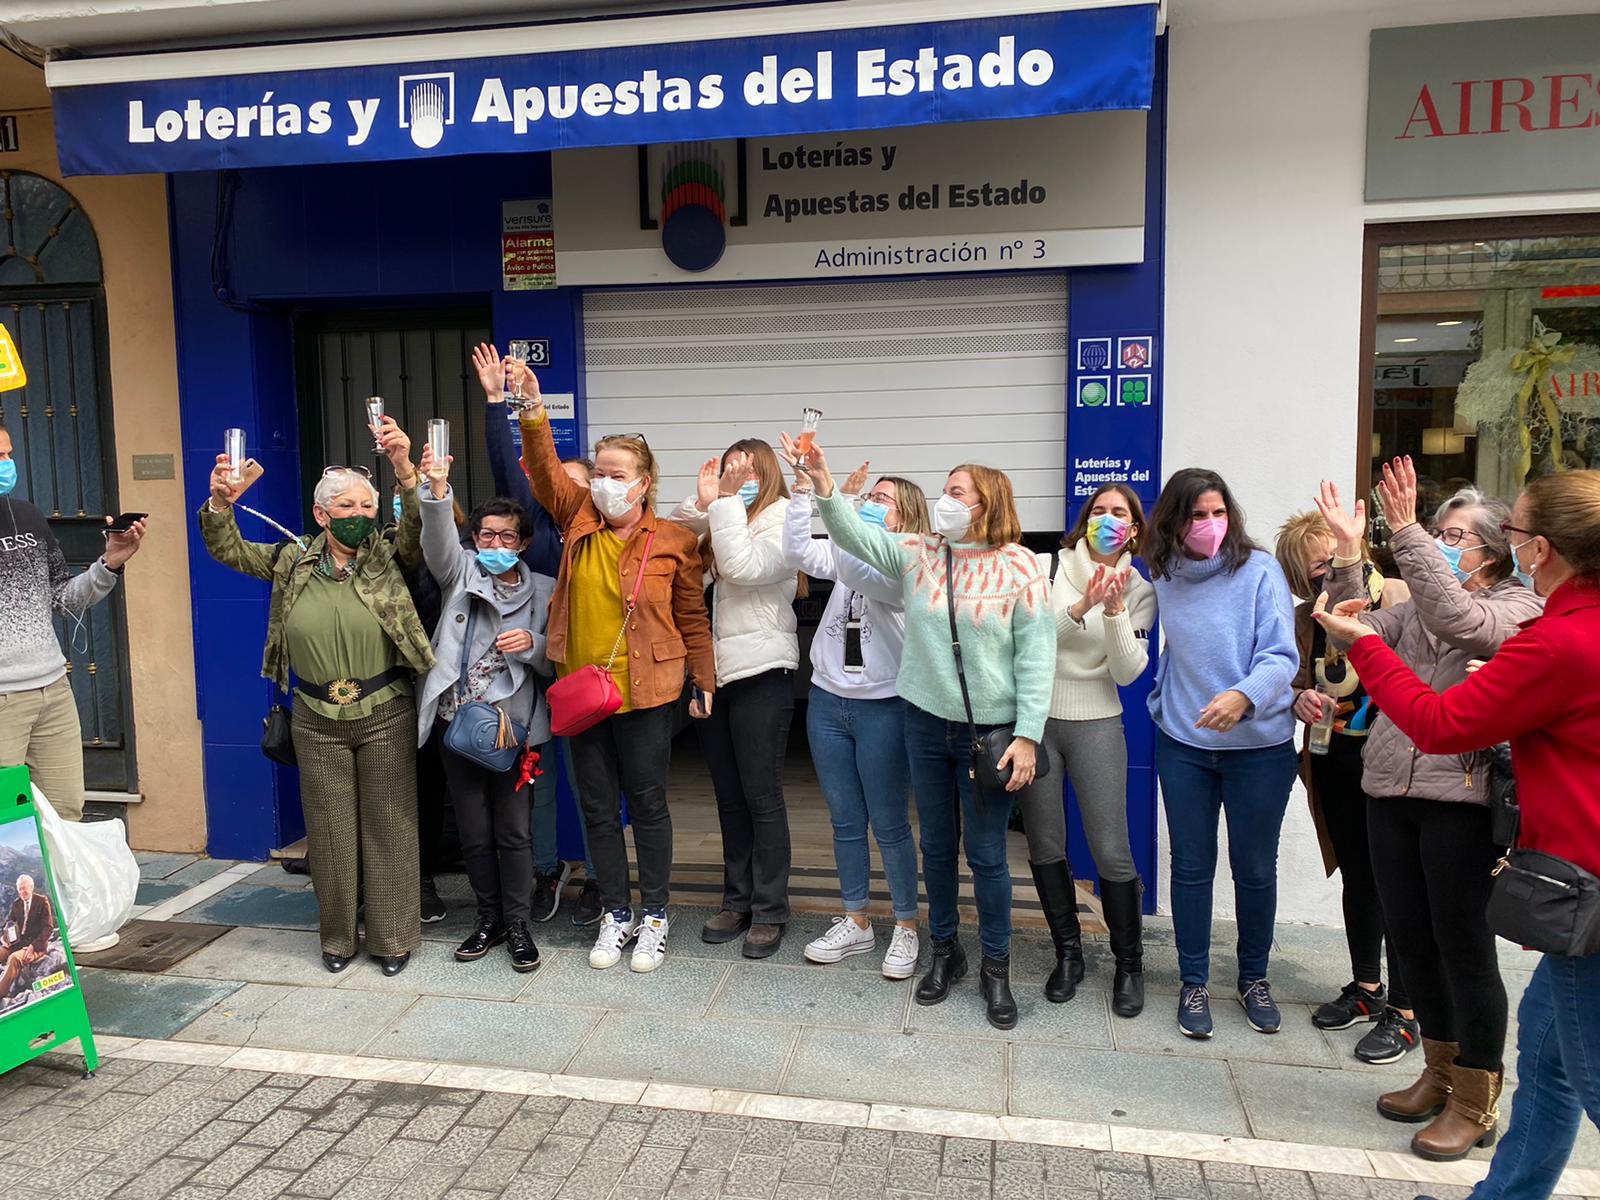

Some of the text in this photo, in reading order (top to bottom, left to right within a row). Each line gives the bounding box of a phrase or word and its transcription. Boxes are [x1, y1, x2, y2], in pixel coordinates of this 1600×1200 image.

[128, 35, 1055, 147] Loterías y Apuestas del Estado
[1394, 73, 1600, 140] AIRE
[0, 117, 17, 150] 1
[762, 142, 897, 171] Loterías y
[763, 179, 1047, 223] Apuestas del Estado
[504, 214, 553, 225] verisure
[505, 237, 553, 248] Alarma
[814, 242, 988, 269] Administración
[1033, 240, 1047, 260] 3
[506, 263, 525, 272] Aviso
[1075, 457, 1131, 470] Loterías y
[1075, 470, 1150, 485] Apuestas del
[1074, 485, 1099, 496] Esta
[0, 532, 38, 552] ESS
[42, 972, 64, 987] ONCE
